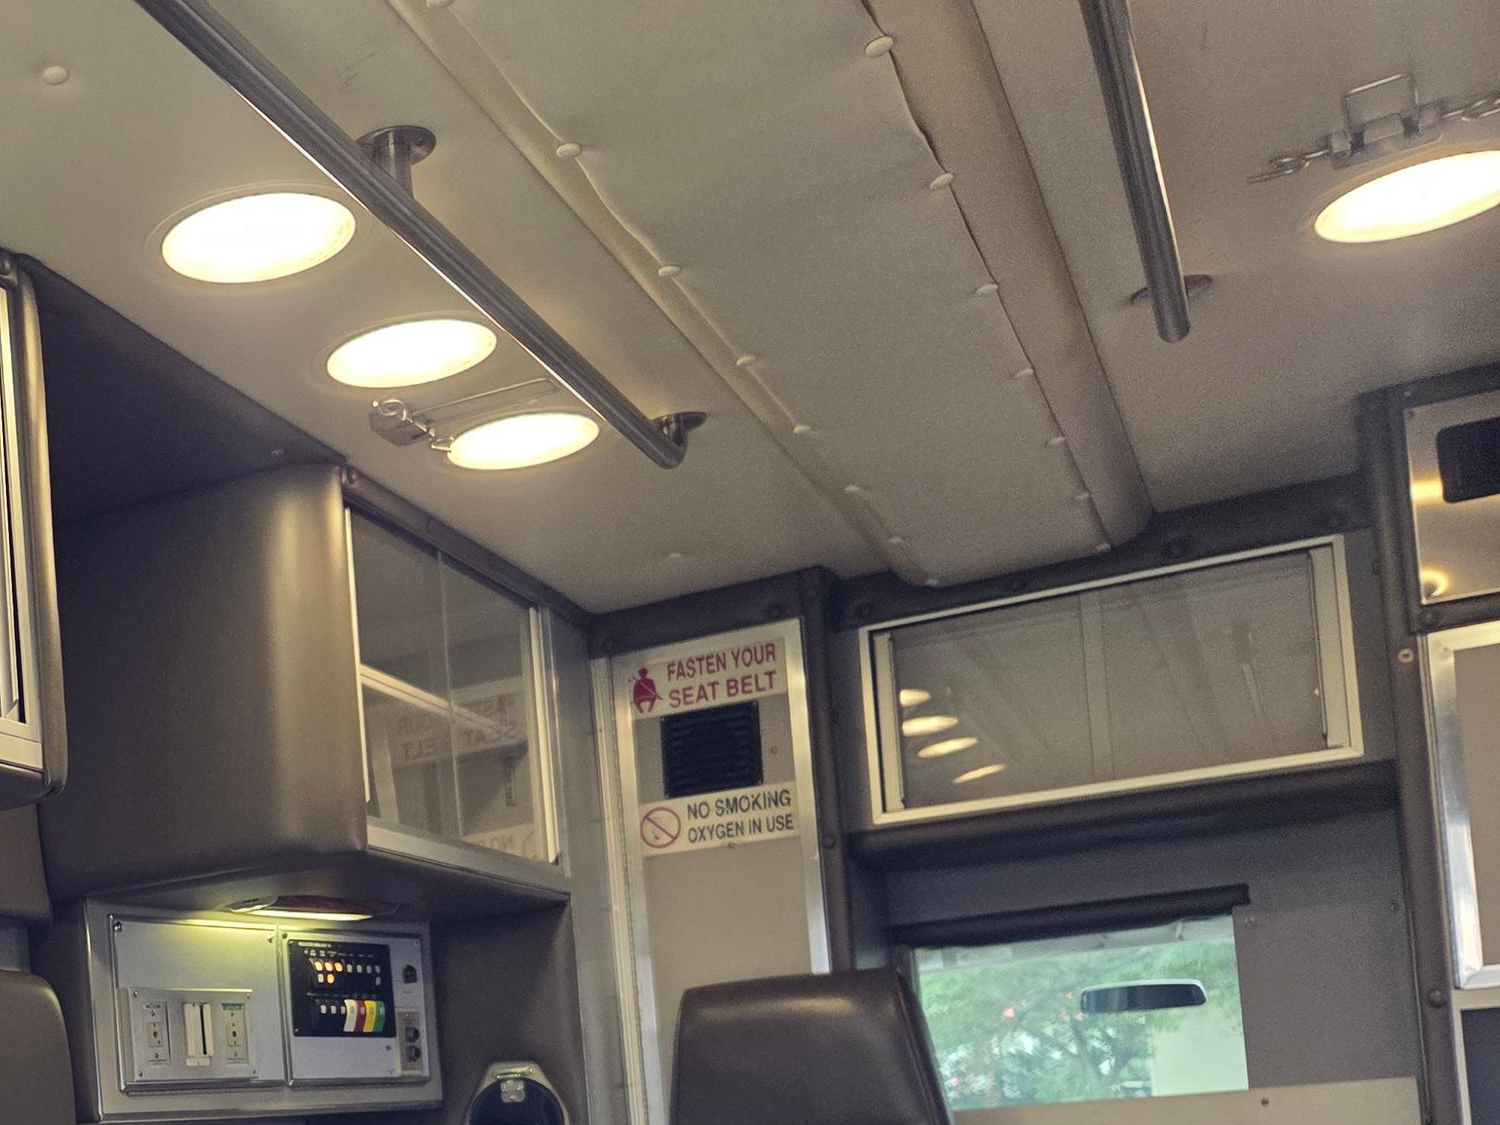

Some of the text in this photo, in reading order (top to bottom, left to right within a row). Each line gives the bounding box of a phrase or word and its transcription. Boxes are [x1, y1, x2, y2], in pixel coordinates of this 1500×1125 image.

[667, 642, 777, 682] FASTEN YOUR
[668, 669, 778, 709] SEAT BELT
[686, 788, 792, 821] NO SMOKING
[687, 814, 794, 844] OXYGEN IN USE
